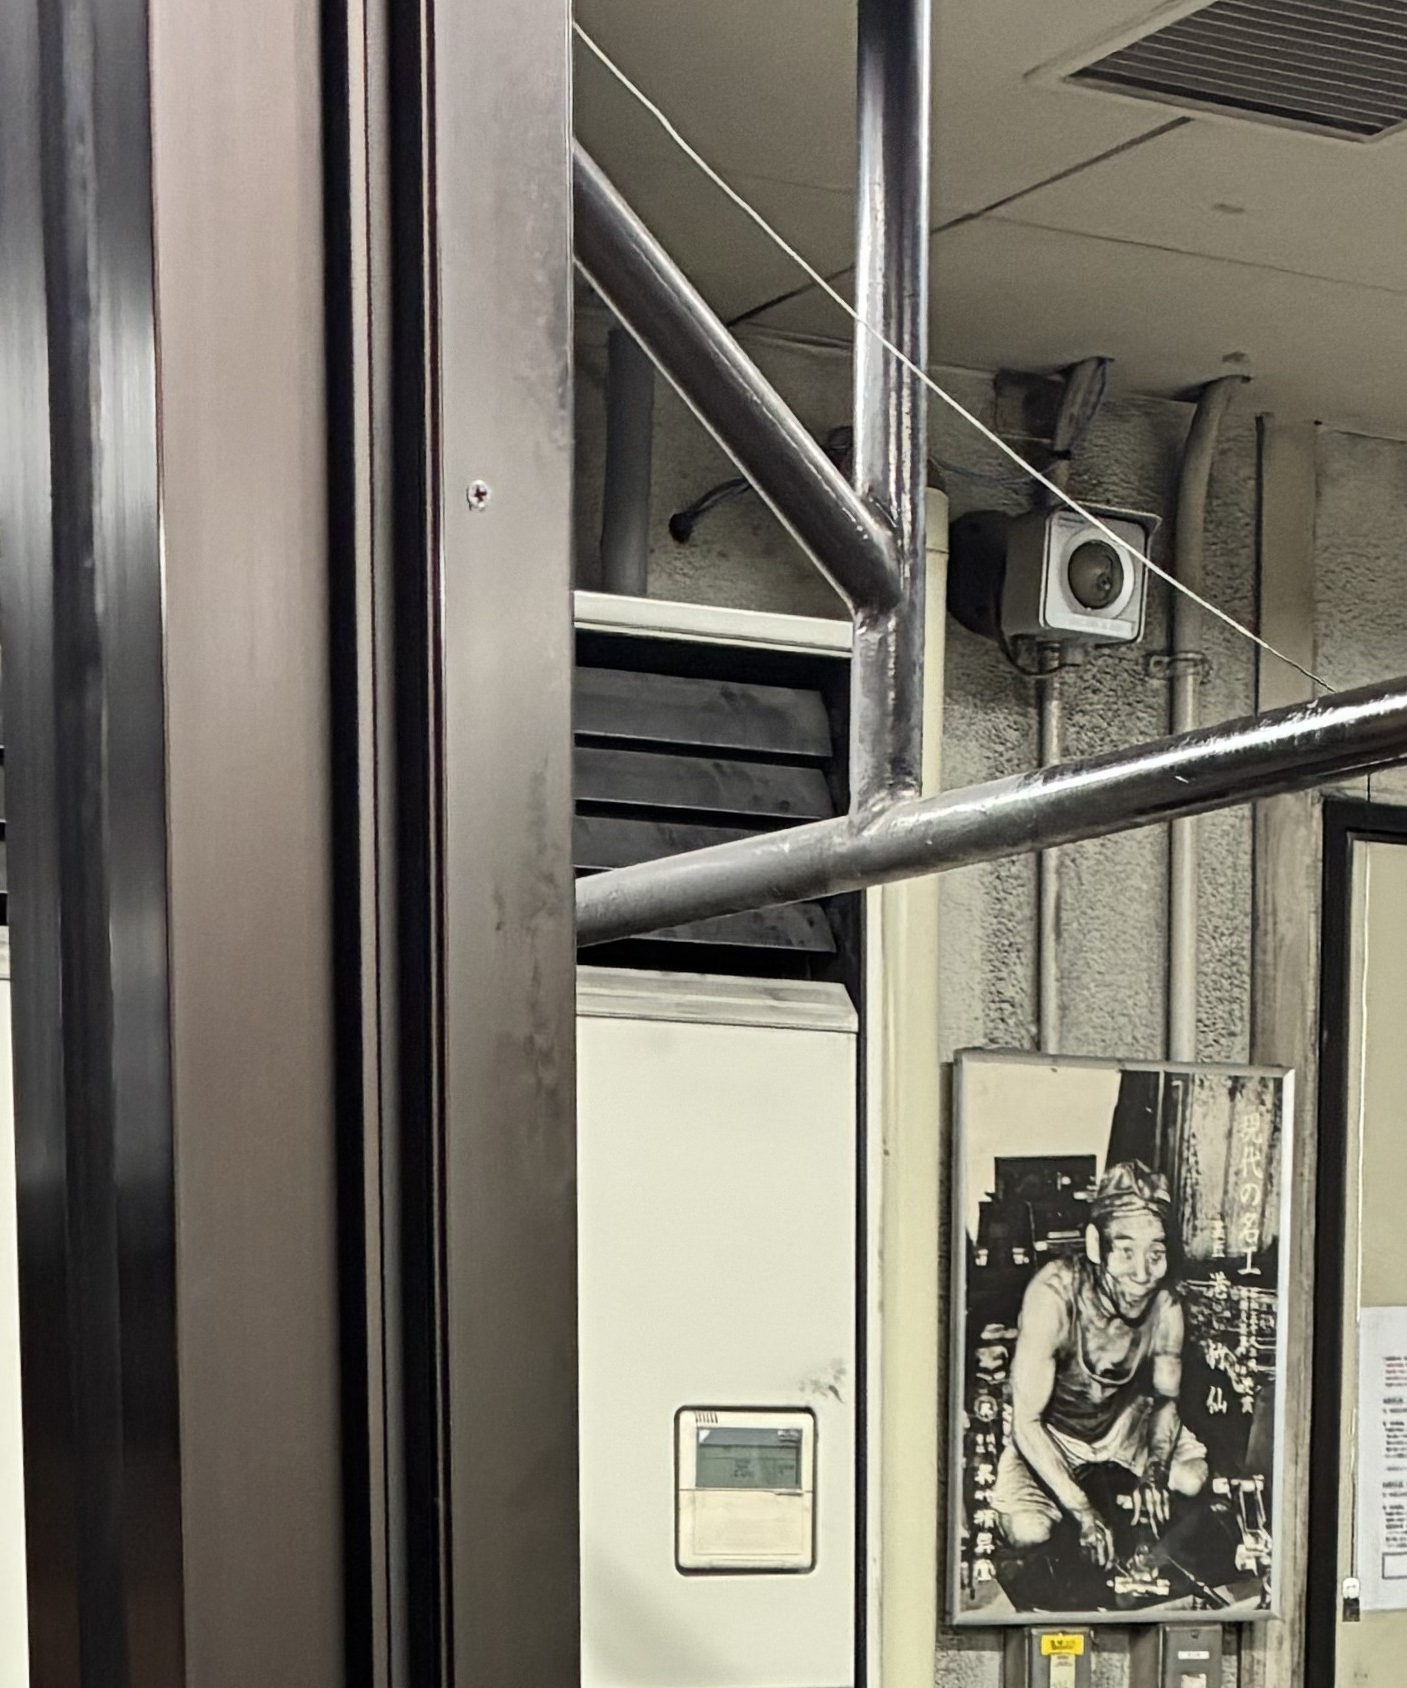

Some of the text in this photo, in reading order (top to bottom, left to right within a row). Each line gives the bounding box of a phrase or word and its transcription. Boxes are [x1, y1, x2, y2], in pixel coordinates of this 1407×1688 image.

[1237, 1113, 1262, 1276] 現代の名工
